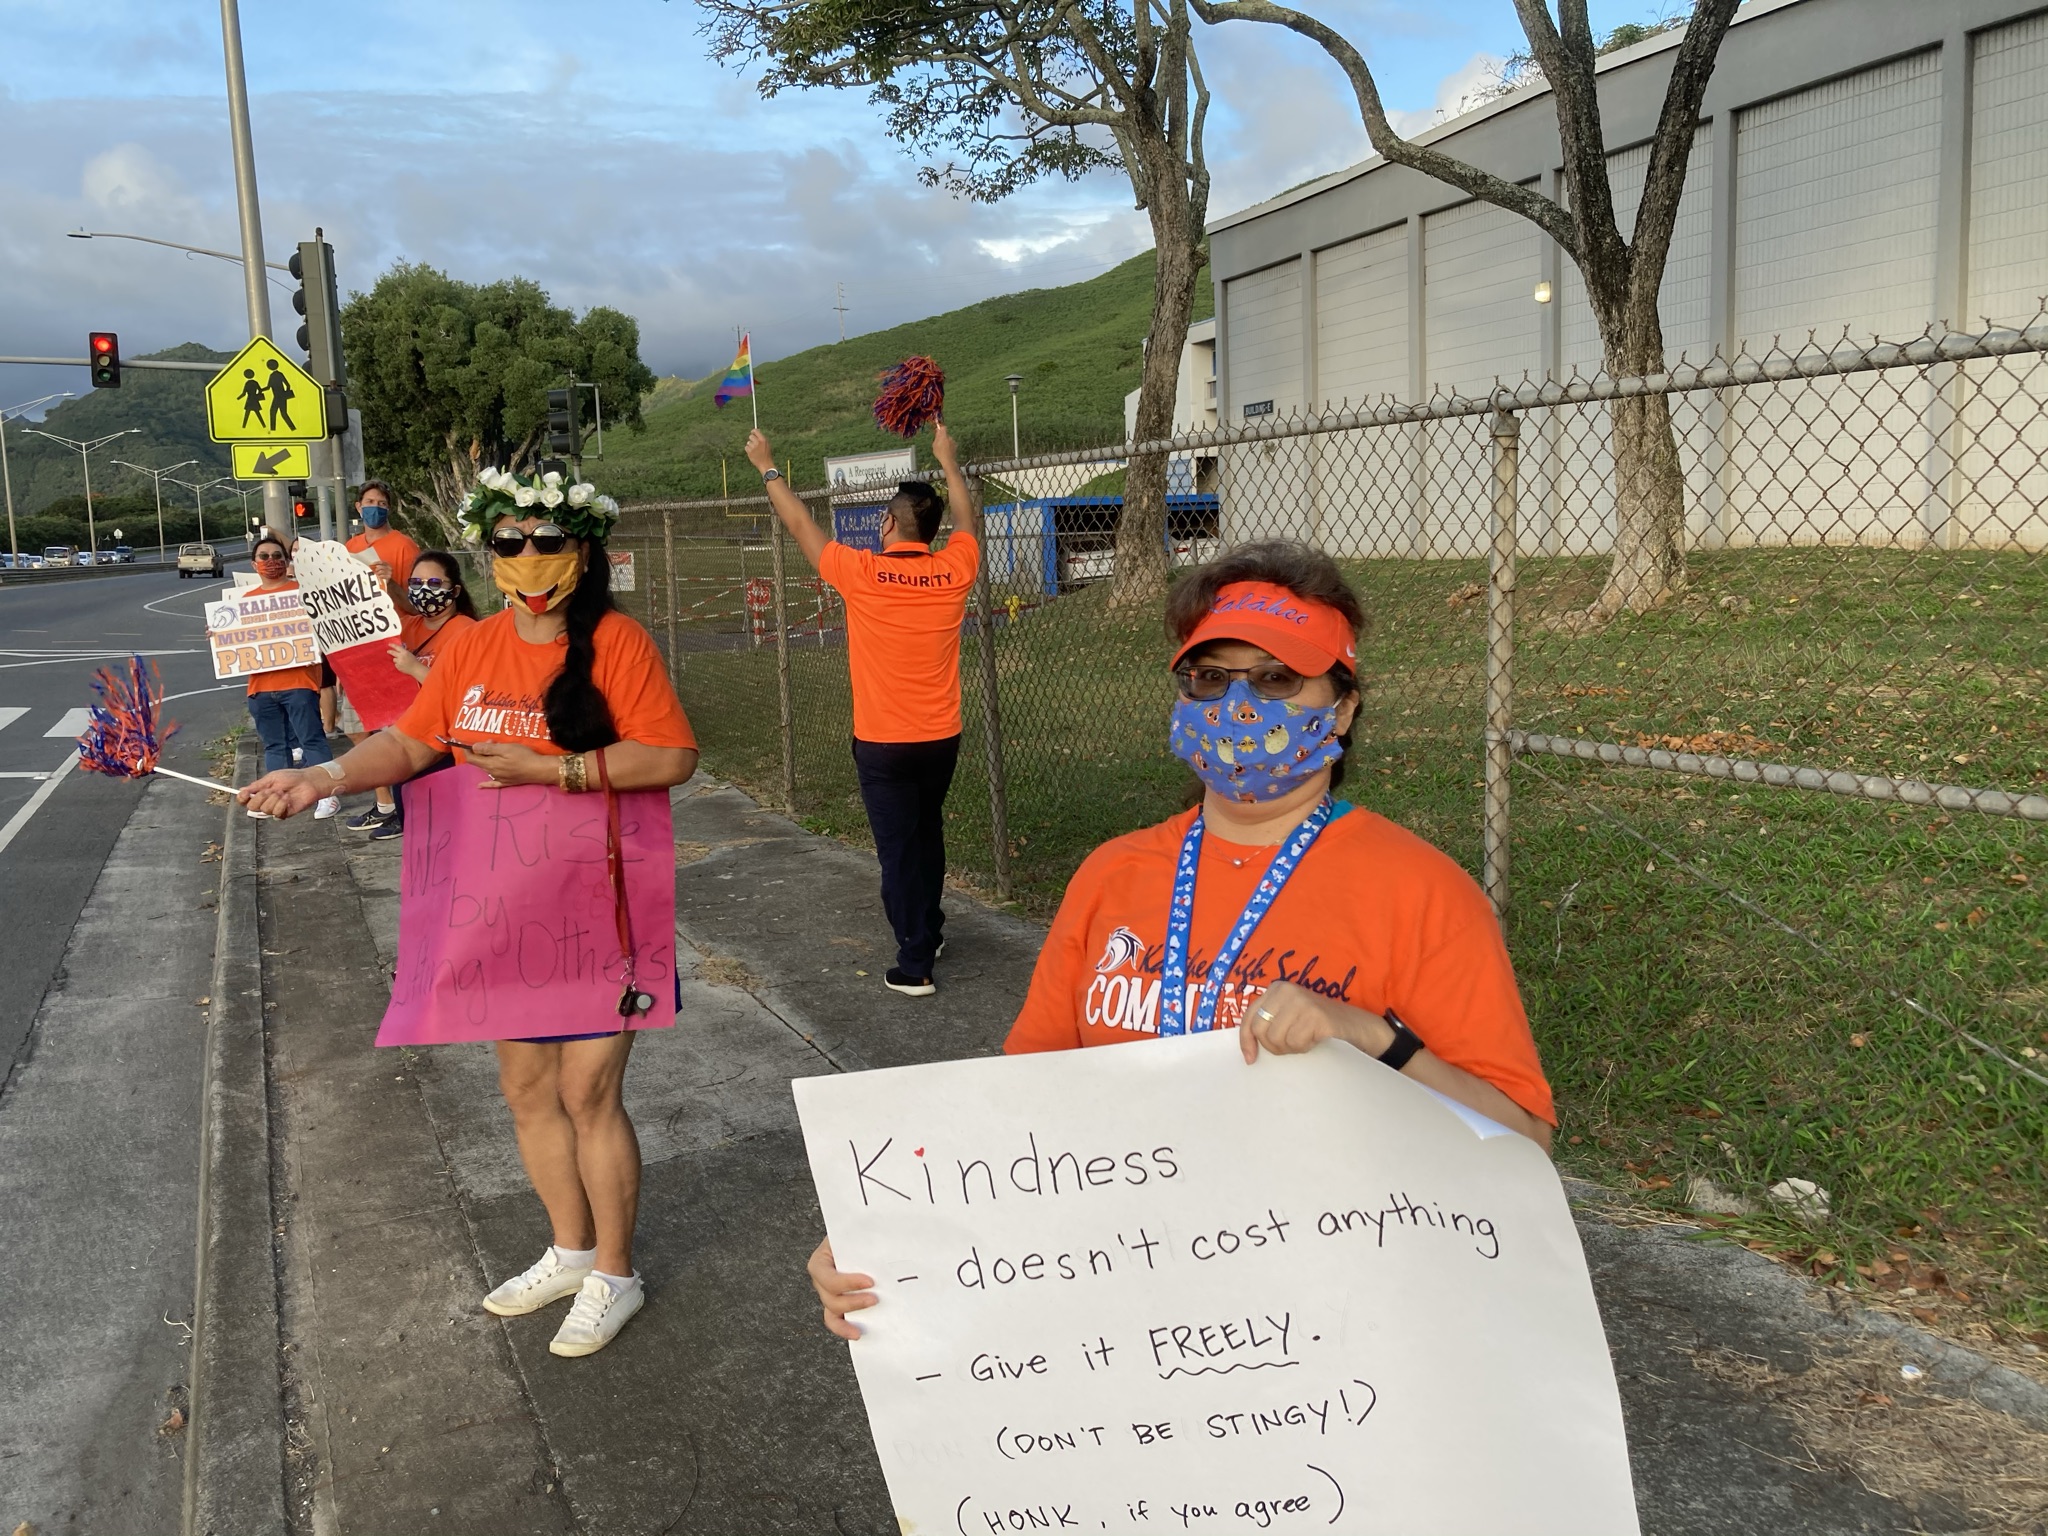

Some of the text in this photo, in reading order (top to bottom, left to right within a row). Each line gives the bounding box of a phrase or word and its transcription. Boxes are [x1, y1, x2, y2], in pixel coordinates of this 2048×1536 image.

[303, 571, 382, 619] SPRINKLE
[877, 571, 951, 587] SECURITY
[217, 622, 310, 646] MUSTANG
[241, 614, 267, 625] HIGH
[313, 607, 390, 652] KINDNESS
[216, 637, 316, 676] PRIDE
[410, 787, 644, 897] We Rise
[449, 878, 511, 957] by
[517, 917, 667, 988] Others
[1273, 950, 1358, 1002] School
[849, 1131, 1178, 1206] Kindness
[957, 1227, 1160, 1290] doesn't
[1192, 1209, 1290, 1260] cost
[1318, 1192, 1499, 1259] anything
[971, 1353, 1048, 1381] Give
[1082, 1336, 1115, 1371] it
[997, 1426, 1105, 1460] (DON'T
[1132, 1422, 1173, 1444] BE
[1127, 1500, 1148, 1522] if
[1171, 1503, 1218, 1528] you
